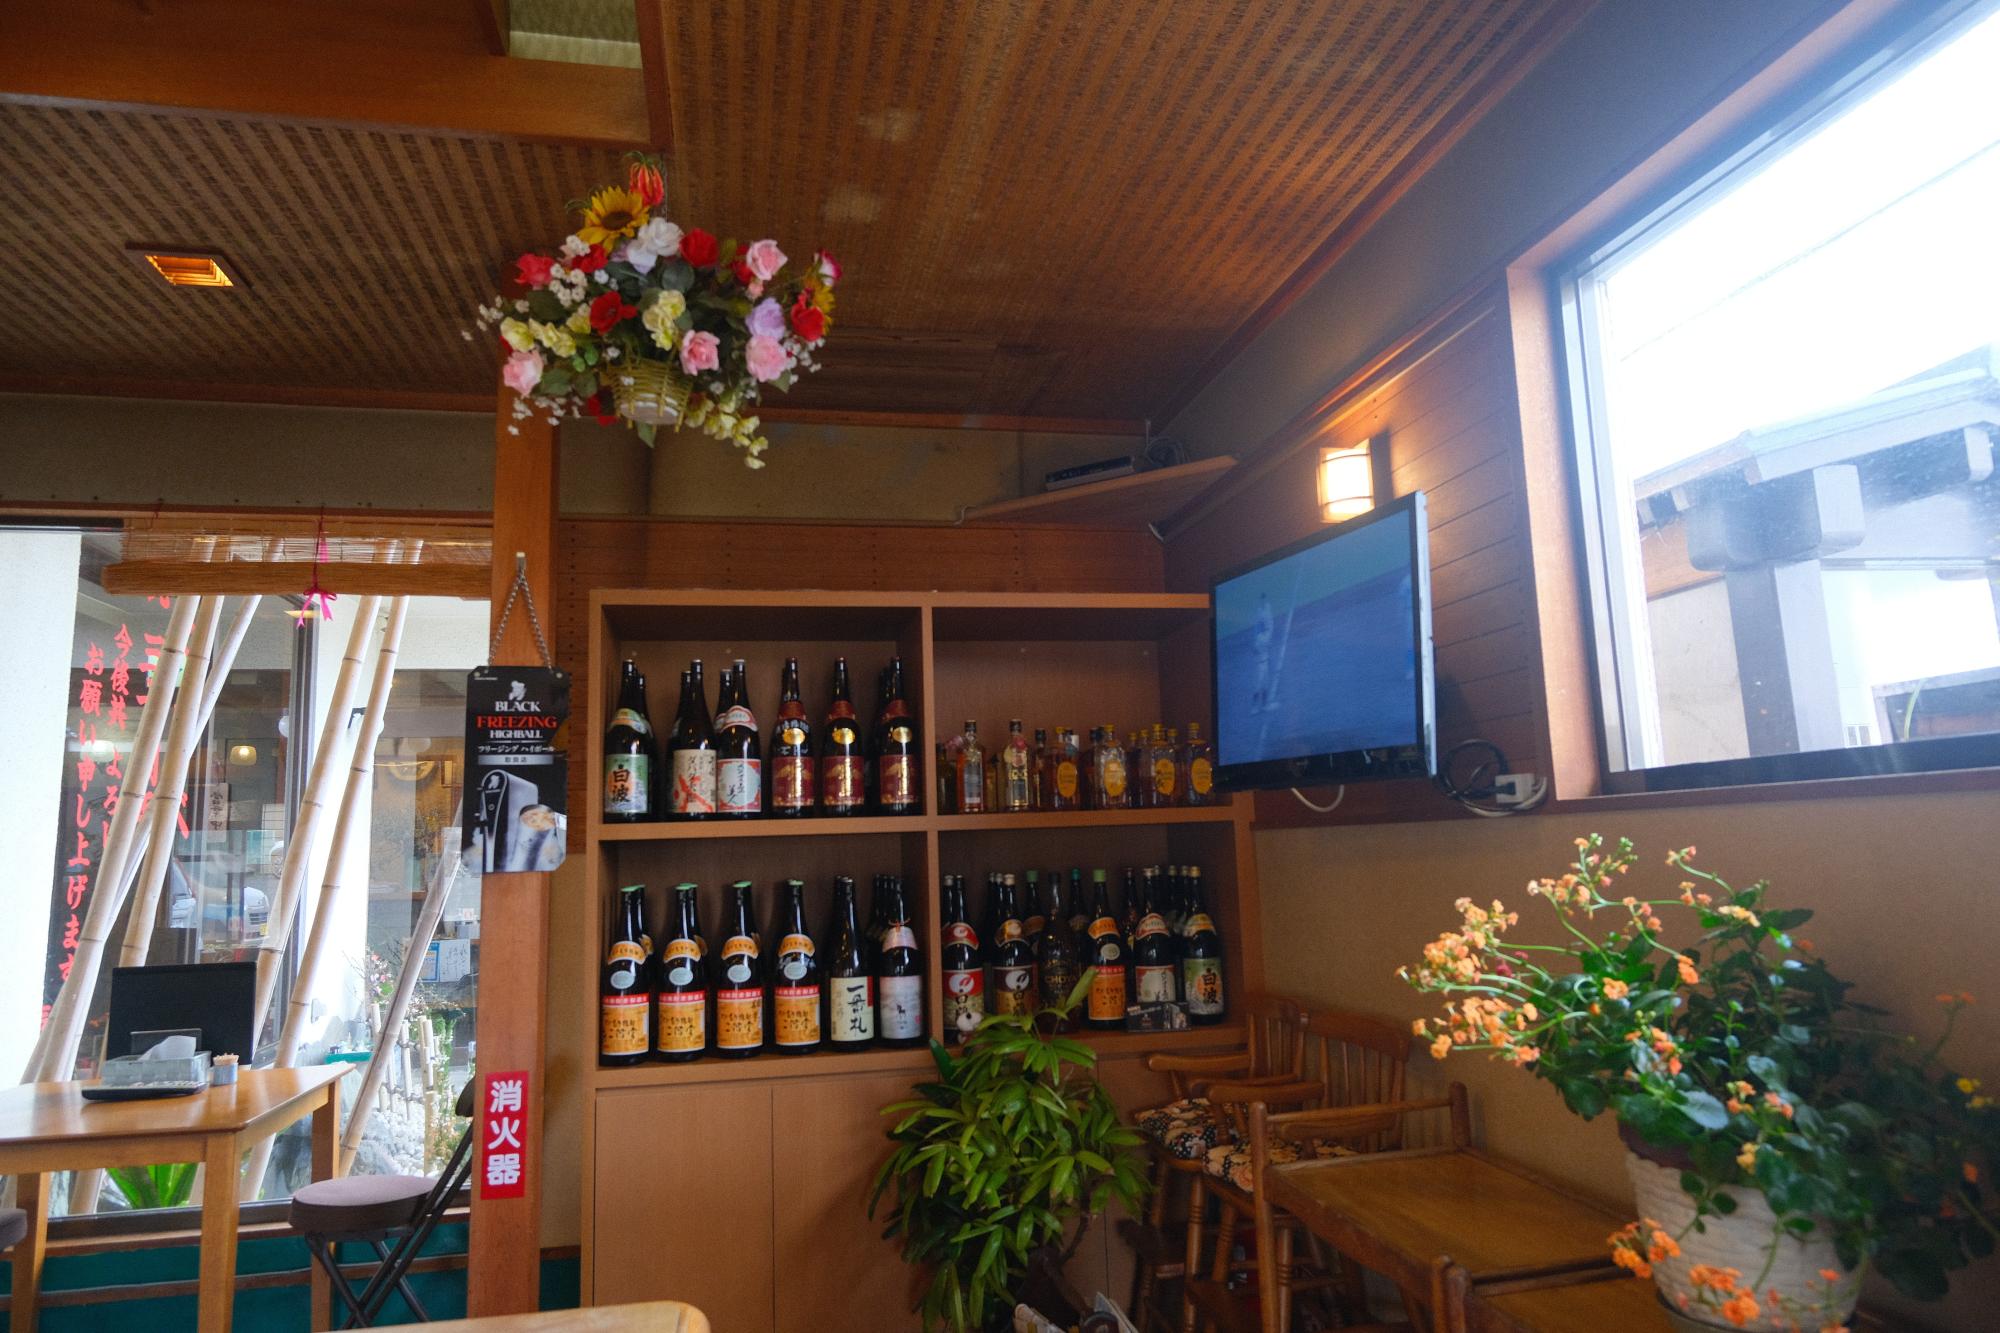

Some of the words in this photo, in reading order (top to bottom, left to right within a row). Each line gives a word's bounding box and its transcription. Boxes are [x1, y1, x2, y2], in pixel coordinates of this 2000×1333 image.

[495, 701, 541, 712] BLACK
[476, 715, 557, 729] FREEZING
[490, 729, 543, 739] HIGHBALL
[487, 1079, 523, 1186] 消火器
